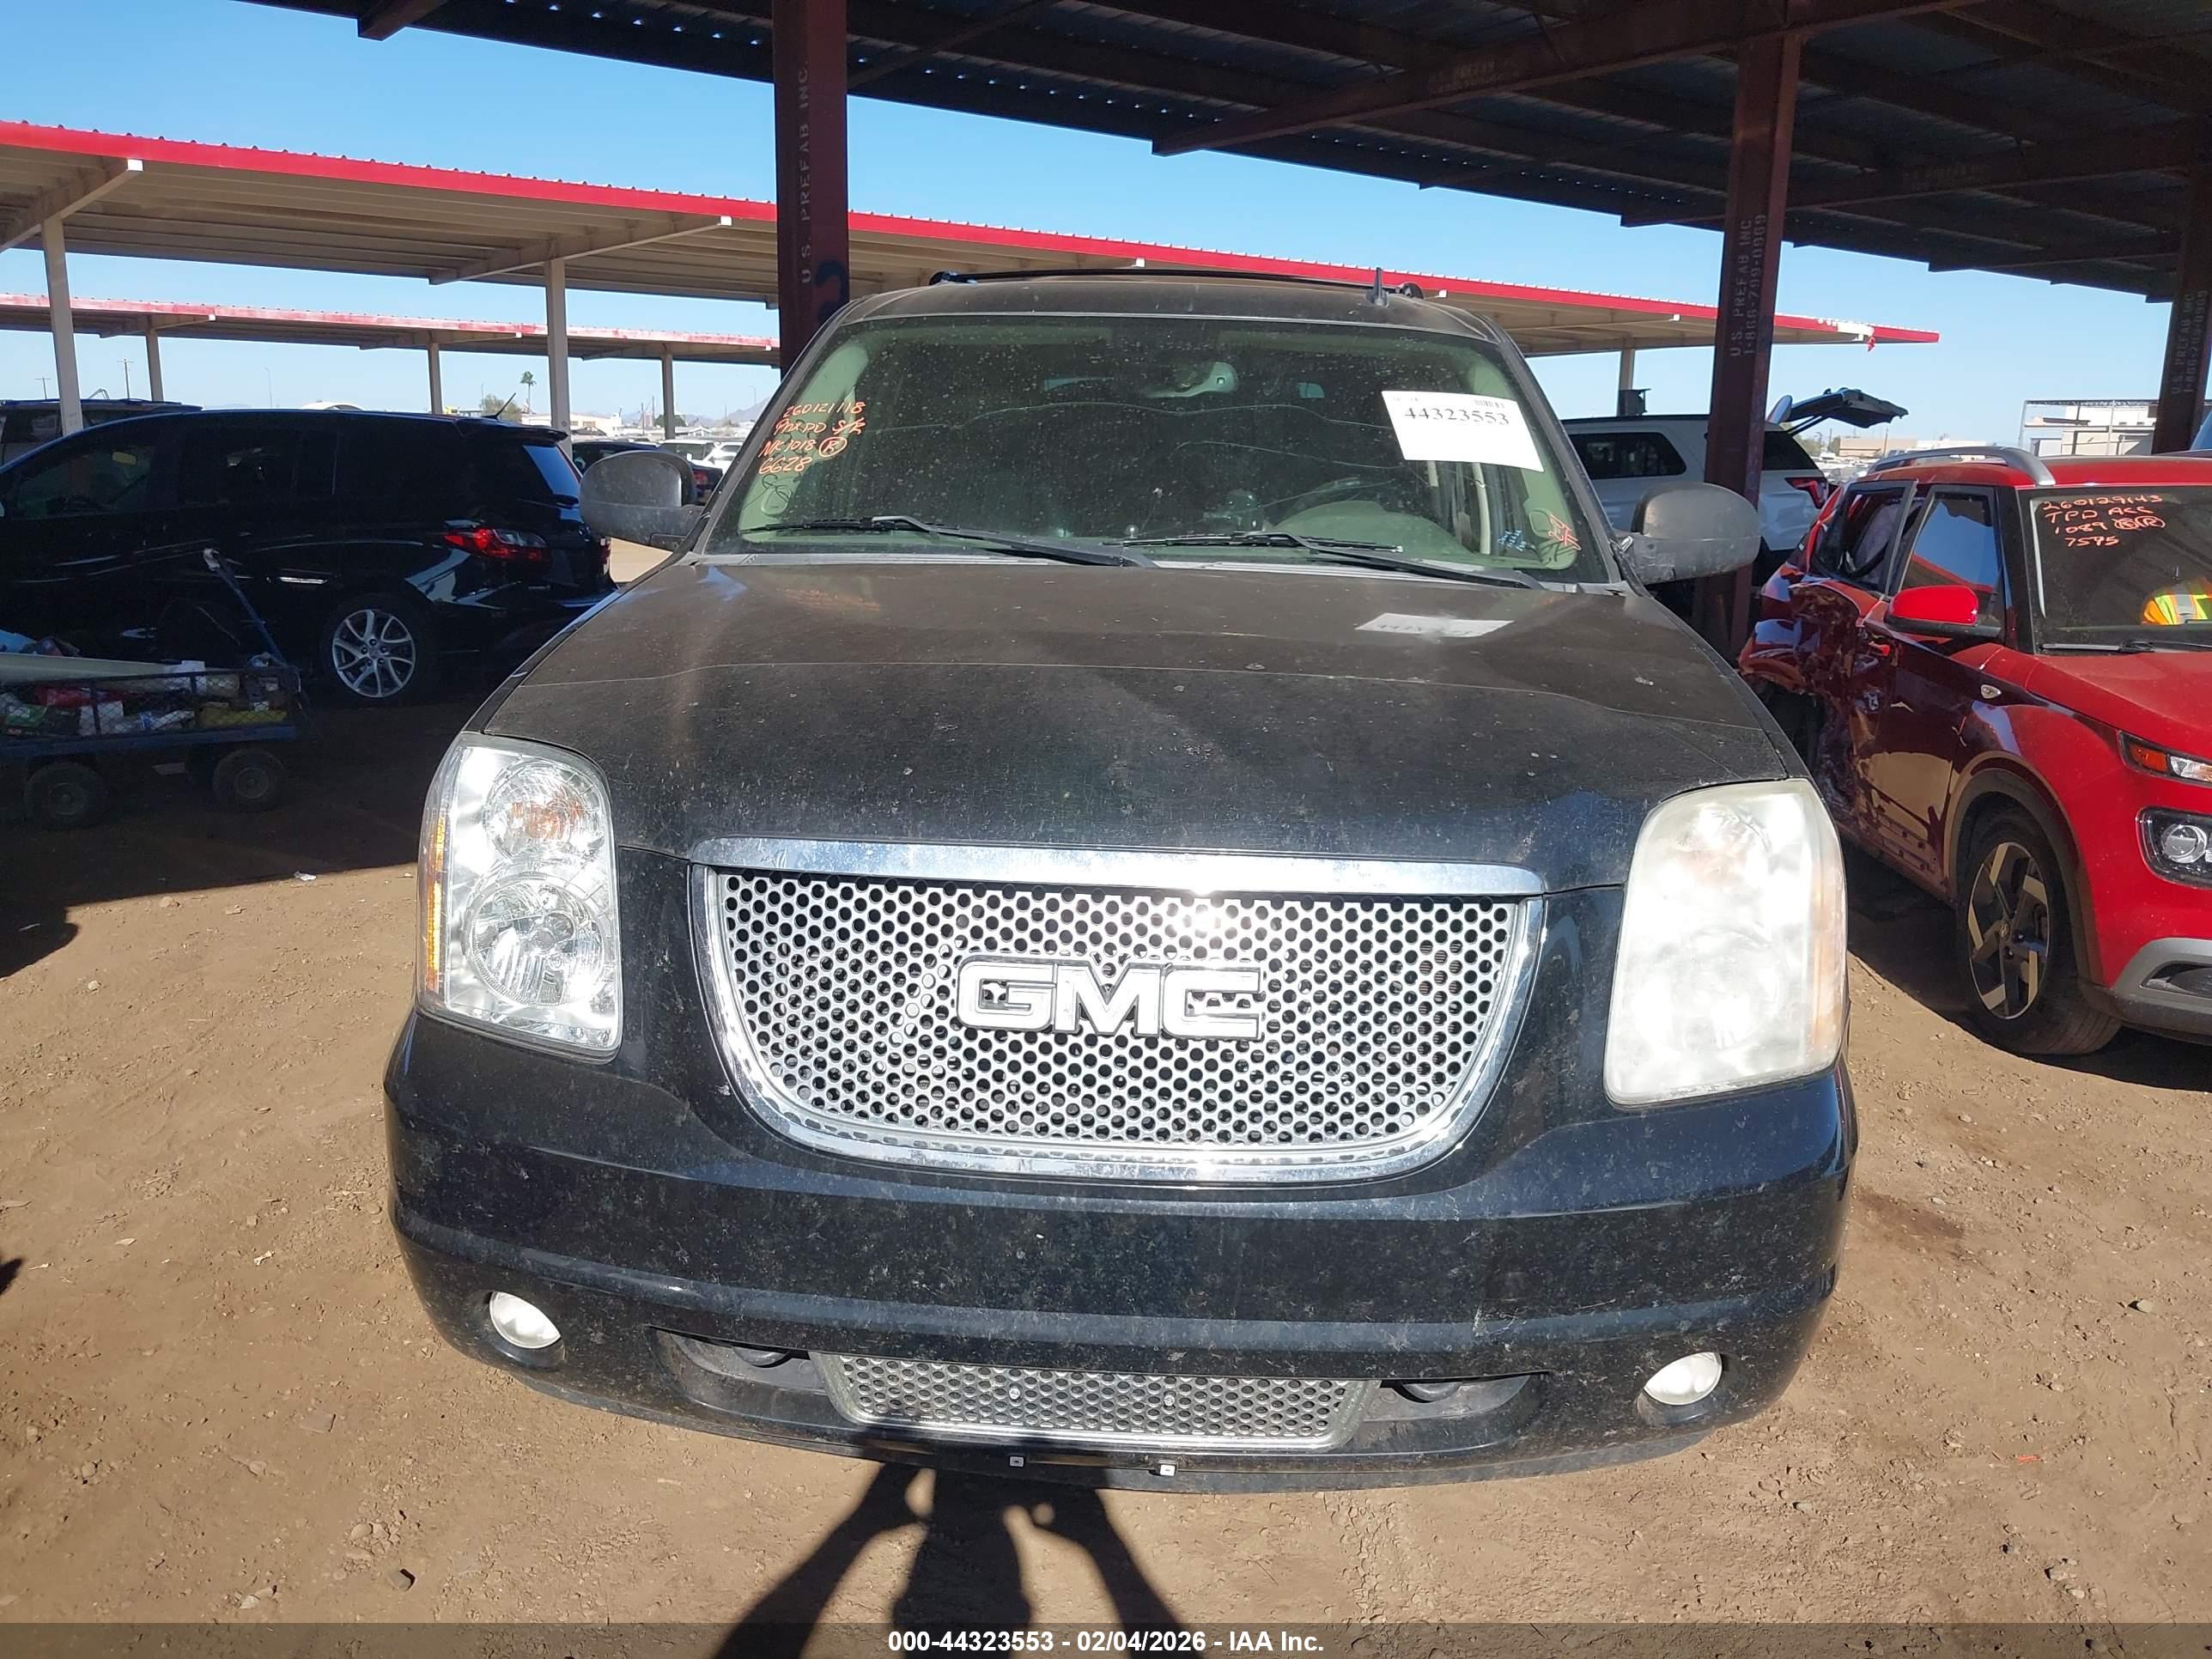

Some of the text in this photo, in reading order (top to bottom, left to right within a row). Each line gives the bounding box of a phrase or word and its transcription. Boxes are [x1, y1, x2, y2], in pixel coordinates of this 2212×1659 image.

[799, 124, 811, 221] PREFAB
[1734, 255, 1750, 317] PREFAB
[1730, 327, 1743, 357] U.S.
[2175, 319, 2191, 367] PREFAB
[1404, 407, 1510, 426] 44323553
[2045, 510, 2099, 524] TPD
[956, 954, 1263, 1041] GMC
